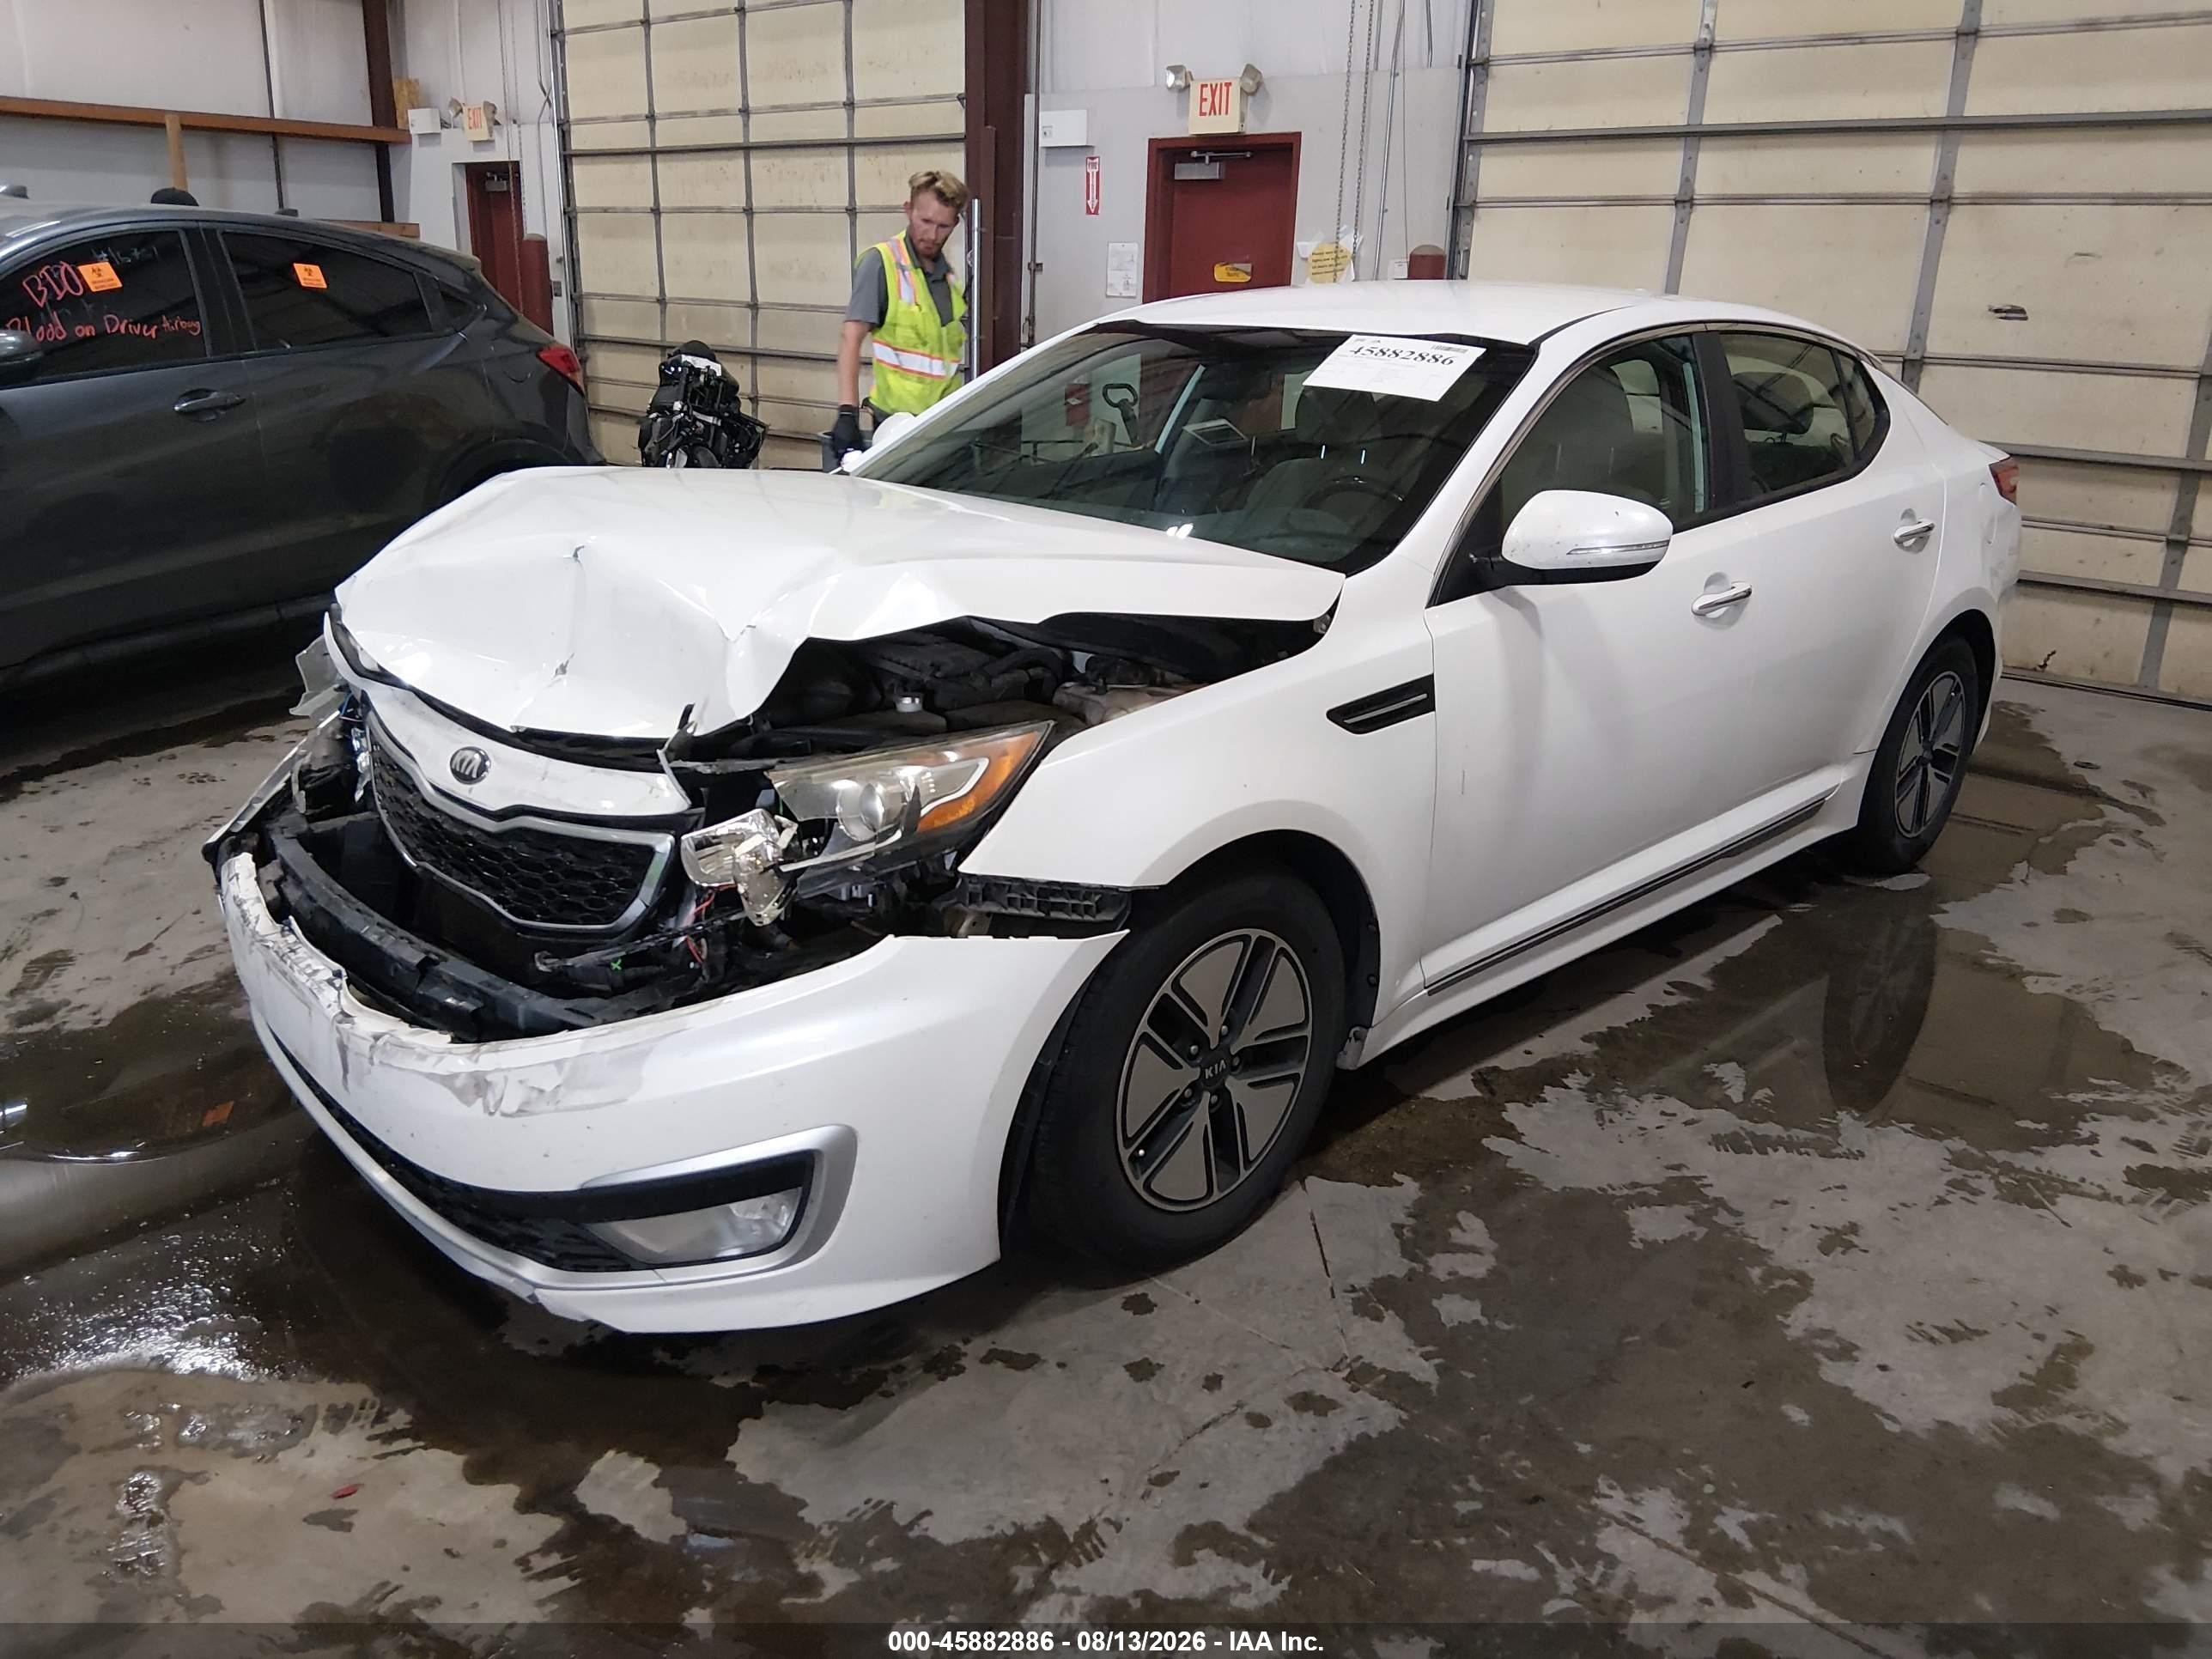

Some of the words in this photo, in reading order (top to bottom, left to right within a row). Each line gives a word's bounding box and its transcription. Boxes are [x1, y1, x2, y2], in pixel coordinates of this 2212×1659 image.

[1199, 82, 1232, 117] EXIT
[467, 106, 483, 130] EXIT
[22, 260, 84, 307] BIO
[75, 324, 96, 337] on
[103, 313, 158, 339] Driver
[1349, 345, 1455, 366] 45882886
[1205, 1060, 1226, 1079] KIA
